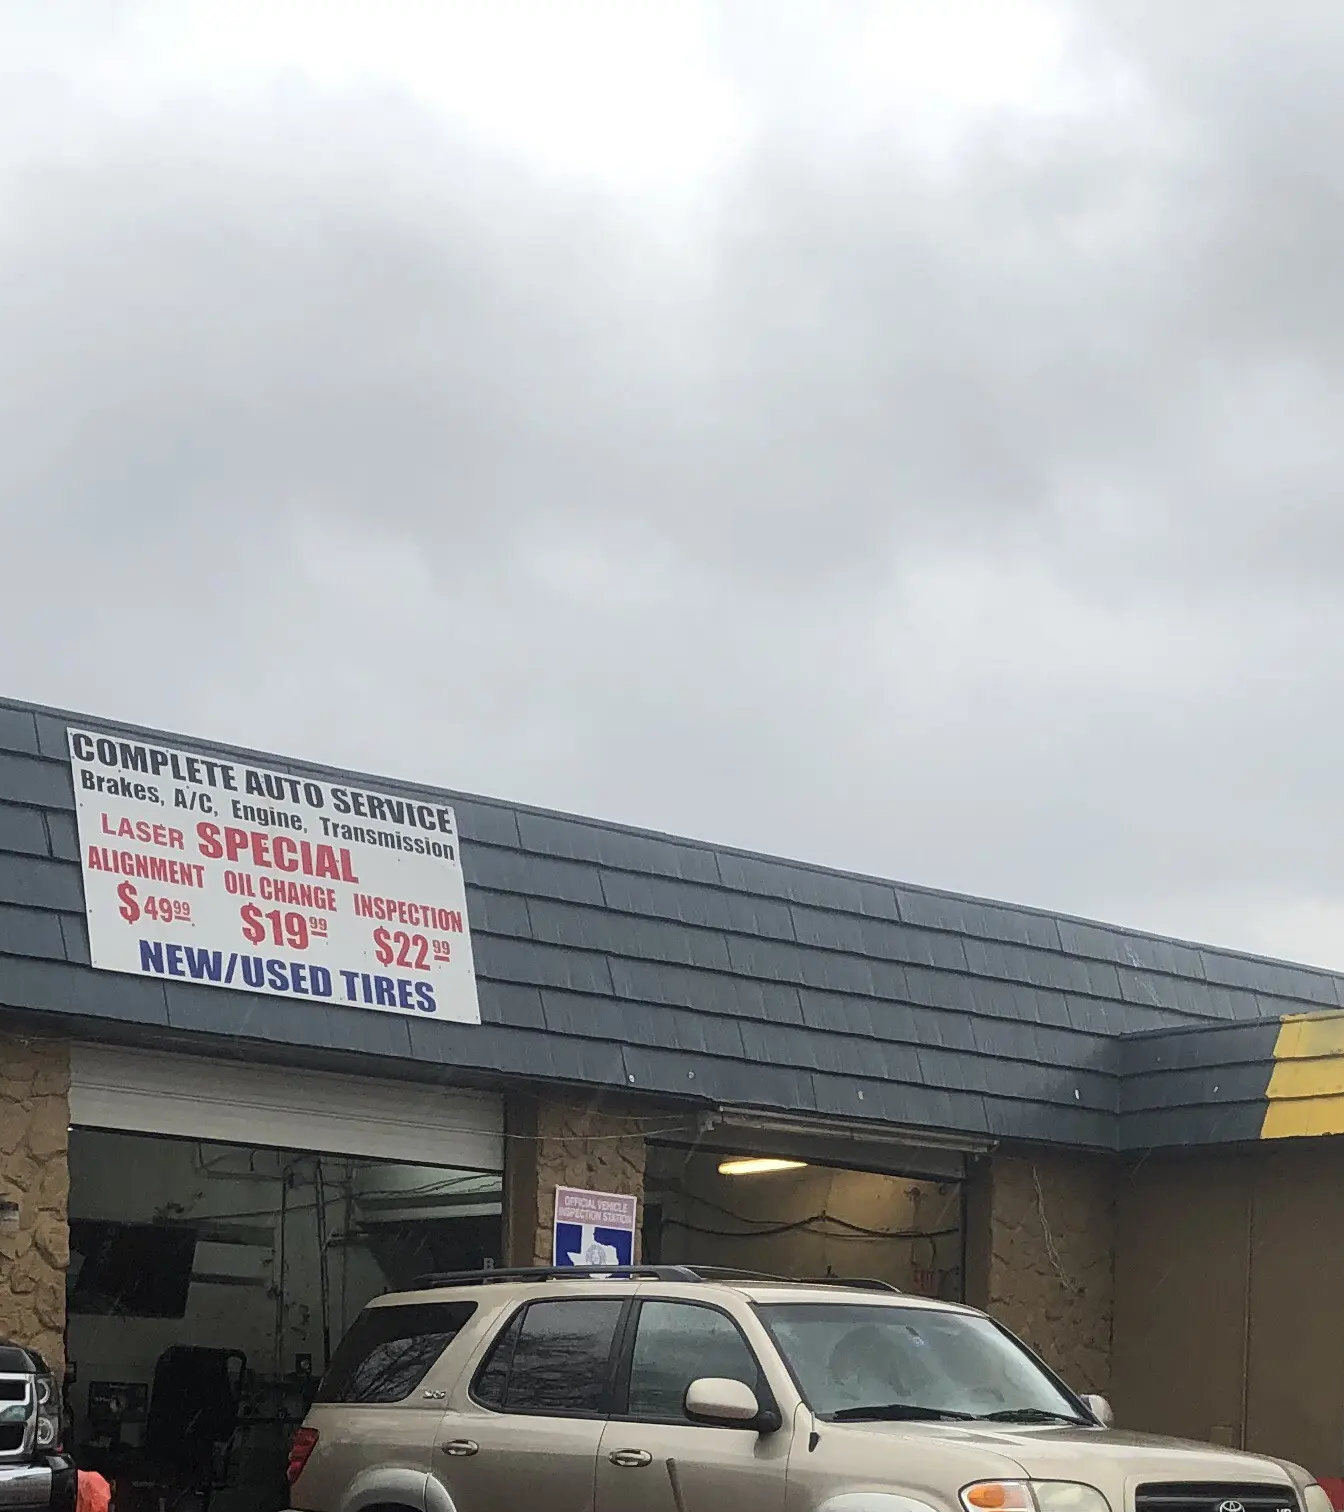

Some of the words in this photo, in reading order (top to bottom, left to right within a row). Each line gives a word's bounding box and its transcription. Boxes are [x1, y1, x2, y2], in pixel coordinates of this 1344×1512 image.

[72, 732, 238, 791] COMPLETE
[245, 771, 324, 810] AUTO
[331, 788, 453, 834] SERVICE
[80, 769, 165, 807] Brakes,
[174, 787, 219, 817] A/C,
[232, 803, 307, 833] Engine,
[319, 816, 455, 860] Transmission
[88, 846, 205, 888] ALIGNMENT
[225, 870, 253, 897] OIL
[259, 876, 337, 912] CHANGE
[354, 893, 463, 932] INSPECTION
[101, 812, 184, 850] LASER
[195, 822, 358, 884] SPECIAL
[139, 939, 332, 998] NEW/USED
[340, 969, 437, 1012] TIRES
